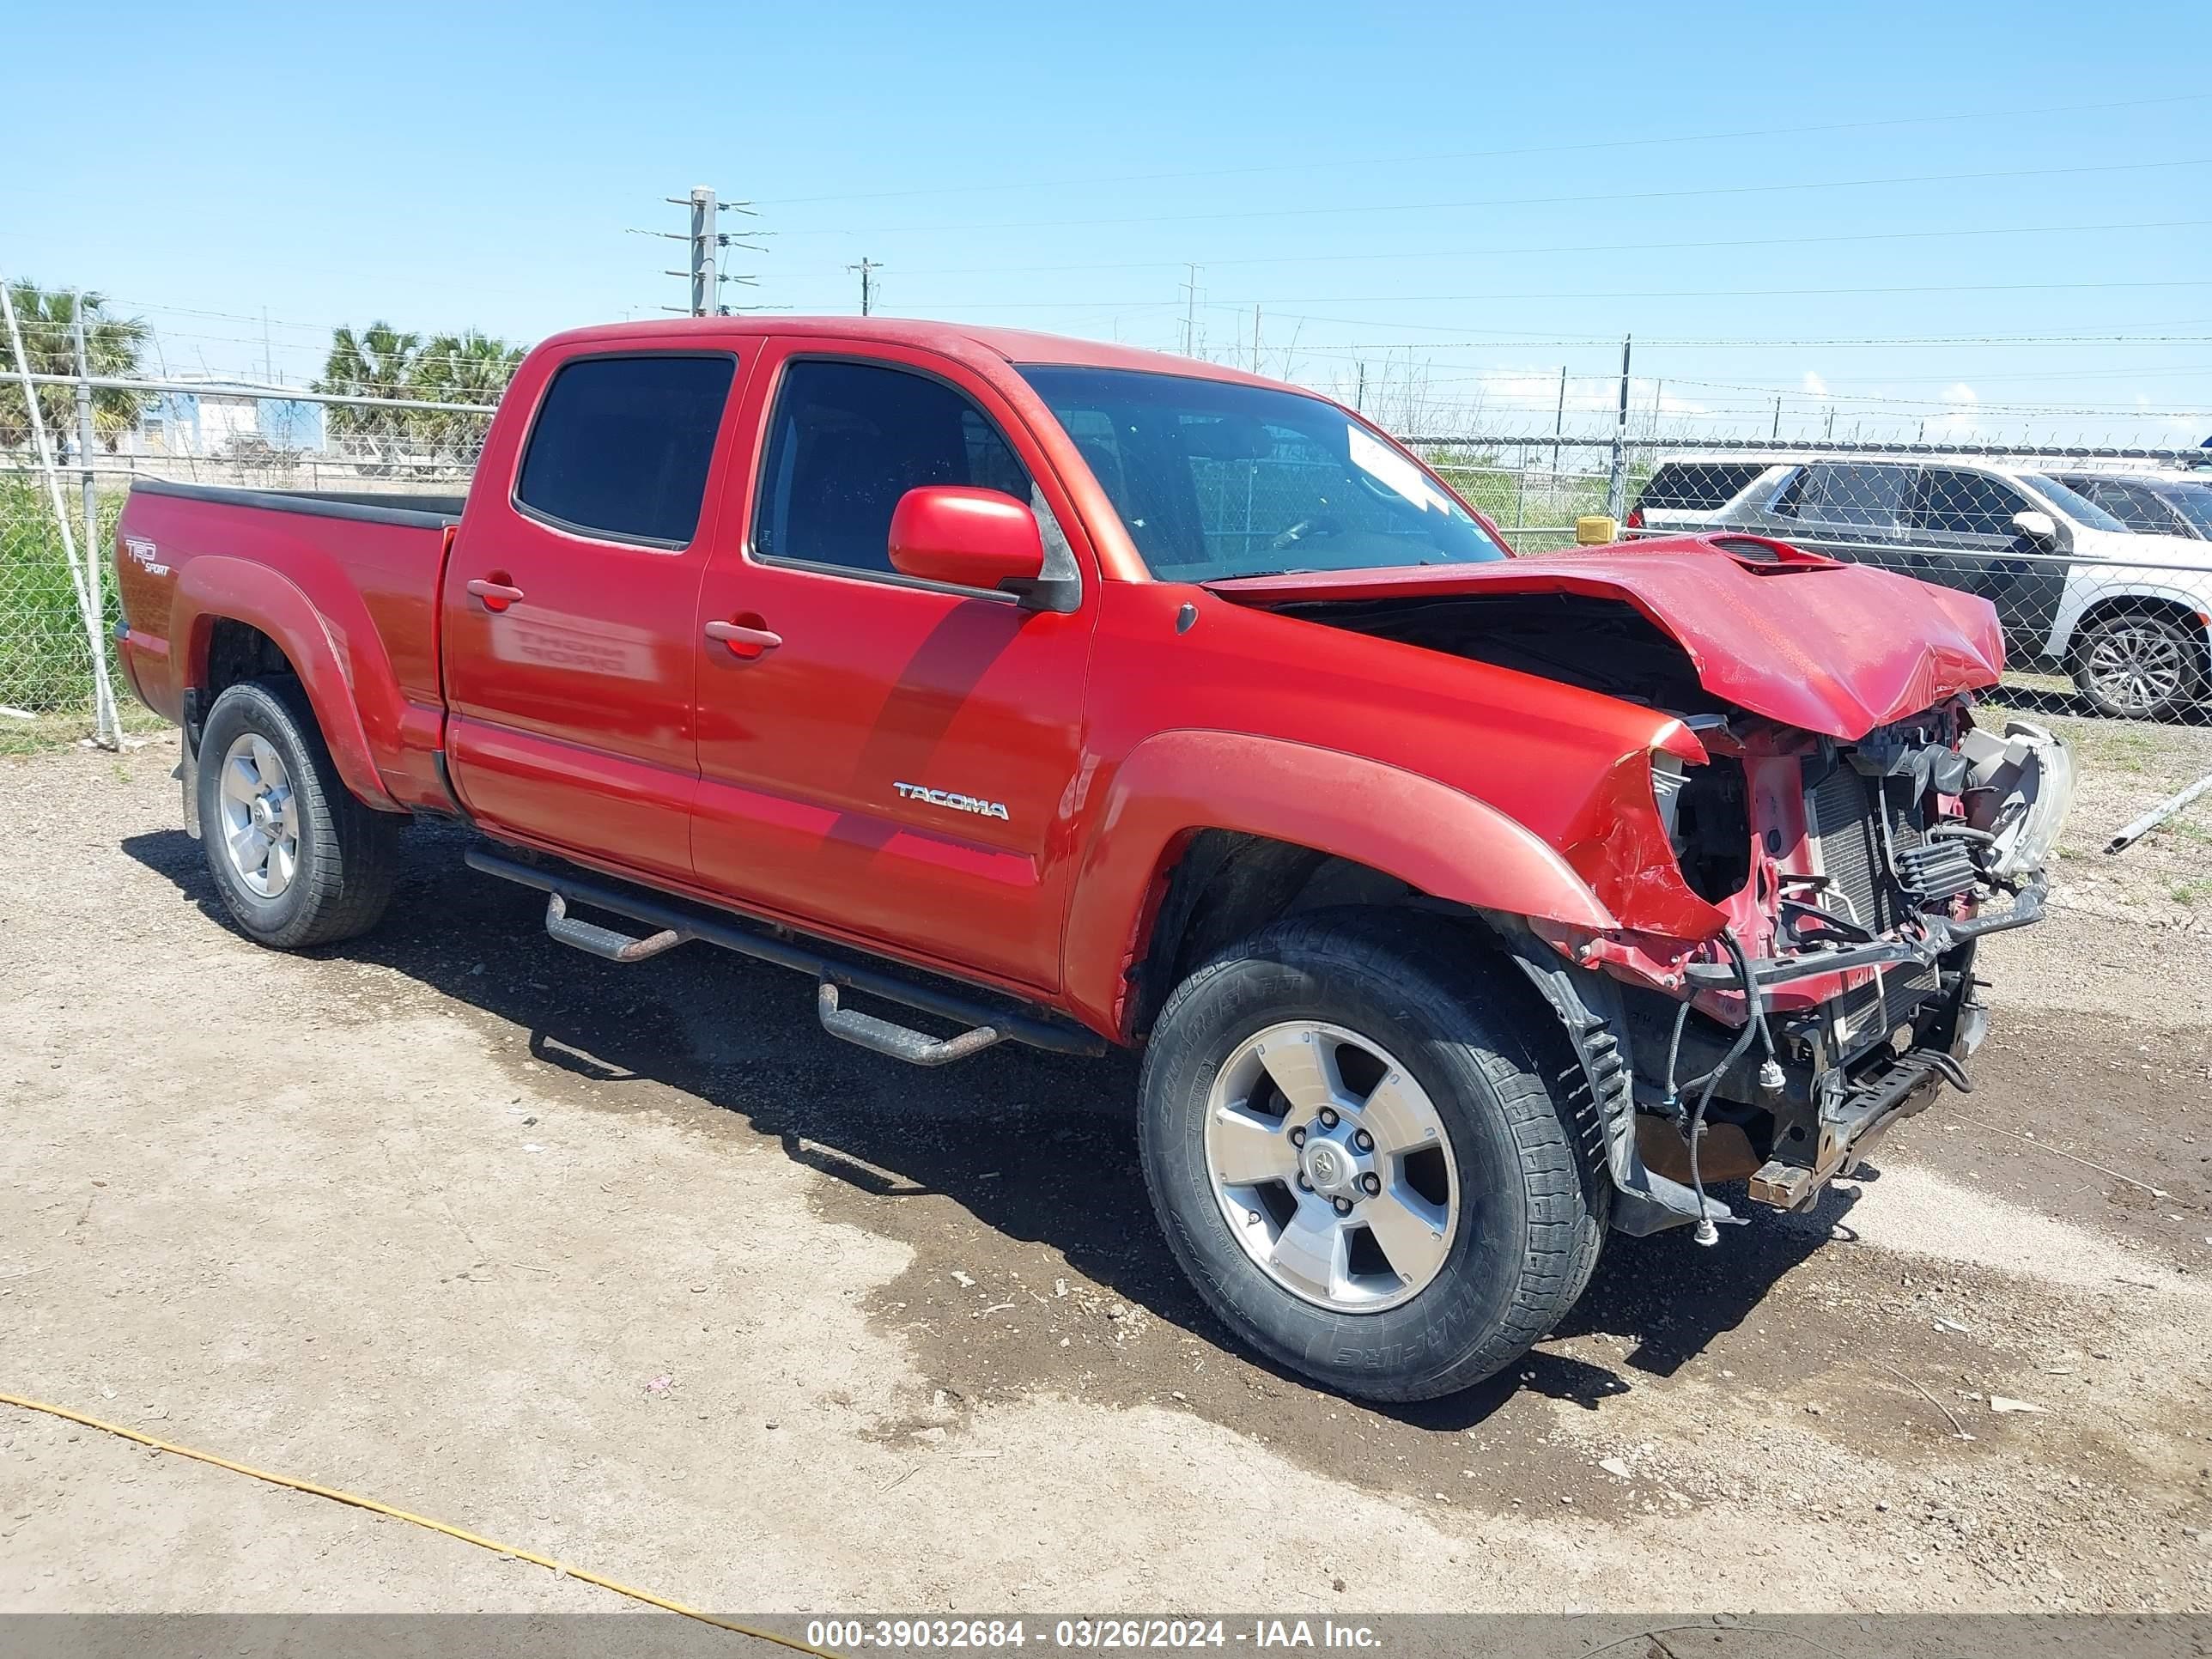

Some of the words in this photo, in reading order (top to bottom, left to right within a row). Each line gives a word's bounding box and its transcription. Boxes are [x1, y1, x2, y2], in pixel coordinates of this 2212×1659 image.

[125, 539, 156, 564] TRD
[144, 562, 171, 577] SPORT
[892, 781, 1010, 821] TACOMA
